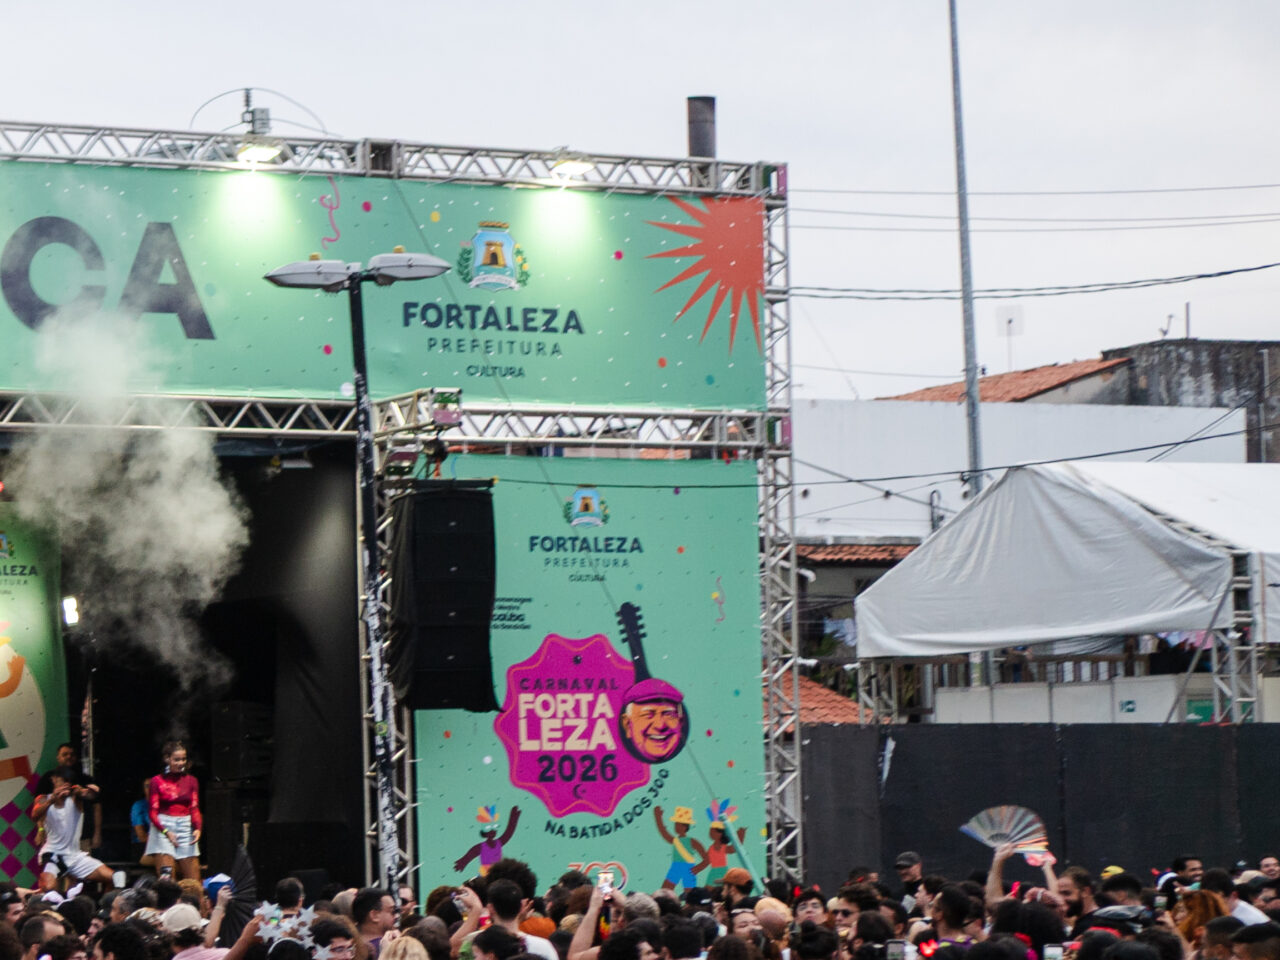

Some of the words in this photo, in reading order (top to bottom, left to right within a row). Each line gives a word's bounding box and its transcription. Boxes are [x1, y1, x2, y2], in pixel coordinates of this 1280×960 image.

[402, 302, 585, 334] FORTALEZA
[427, 337, 562, 356] PREFEITURA
[466, 364, 525, 378] CULTURA
[529, 535, 643, 553] FORTALEZA
[544, 557, 630, 568] PREFEITURA
[519, 678, 619, 691] CARNAVAL
[518, 693, 614, 719] FORTA
[518, 718, 617, 752] LEZA
[537, 754, 618, 782] 2026
[544, 819, 566, 838] NA
[570, 818, 623, 839] BATIDA
[623, 798, 652, 825] DOS
[648, 768, 670, 798] 300
